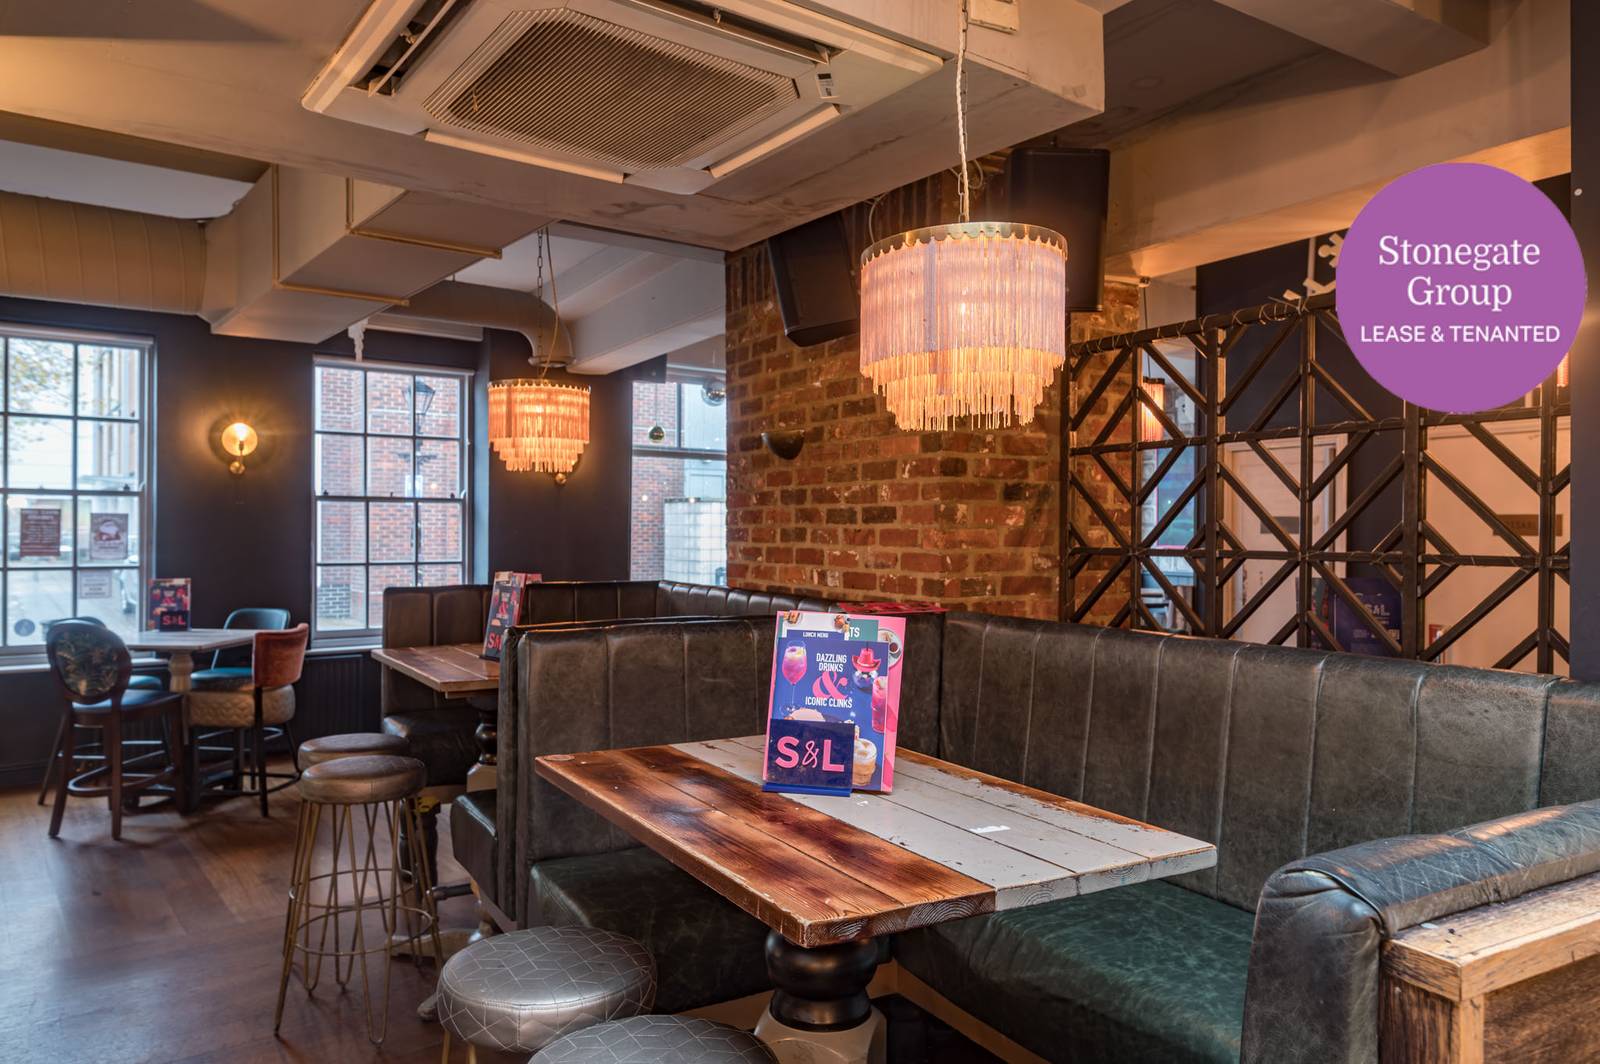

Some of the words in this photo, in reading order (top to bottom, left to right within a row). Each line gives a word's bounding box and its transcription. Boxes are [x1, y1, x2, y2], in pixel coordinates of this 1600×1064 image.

[816, 652, 847, 664] DAZZLING
[818, 662, 844, 673] DRINKS
[812, 671, 849, 699] &
[805, 696, 828, 708] ICONIC
[828, 698, 853, 709] CLINKS
[775, 735, 845, 773] S&L
